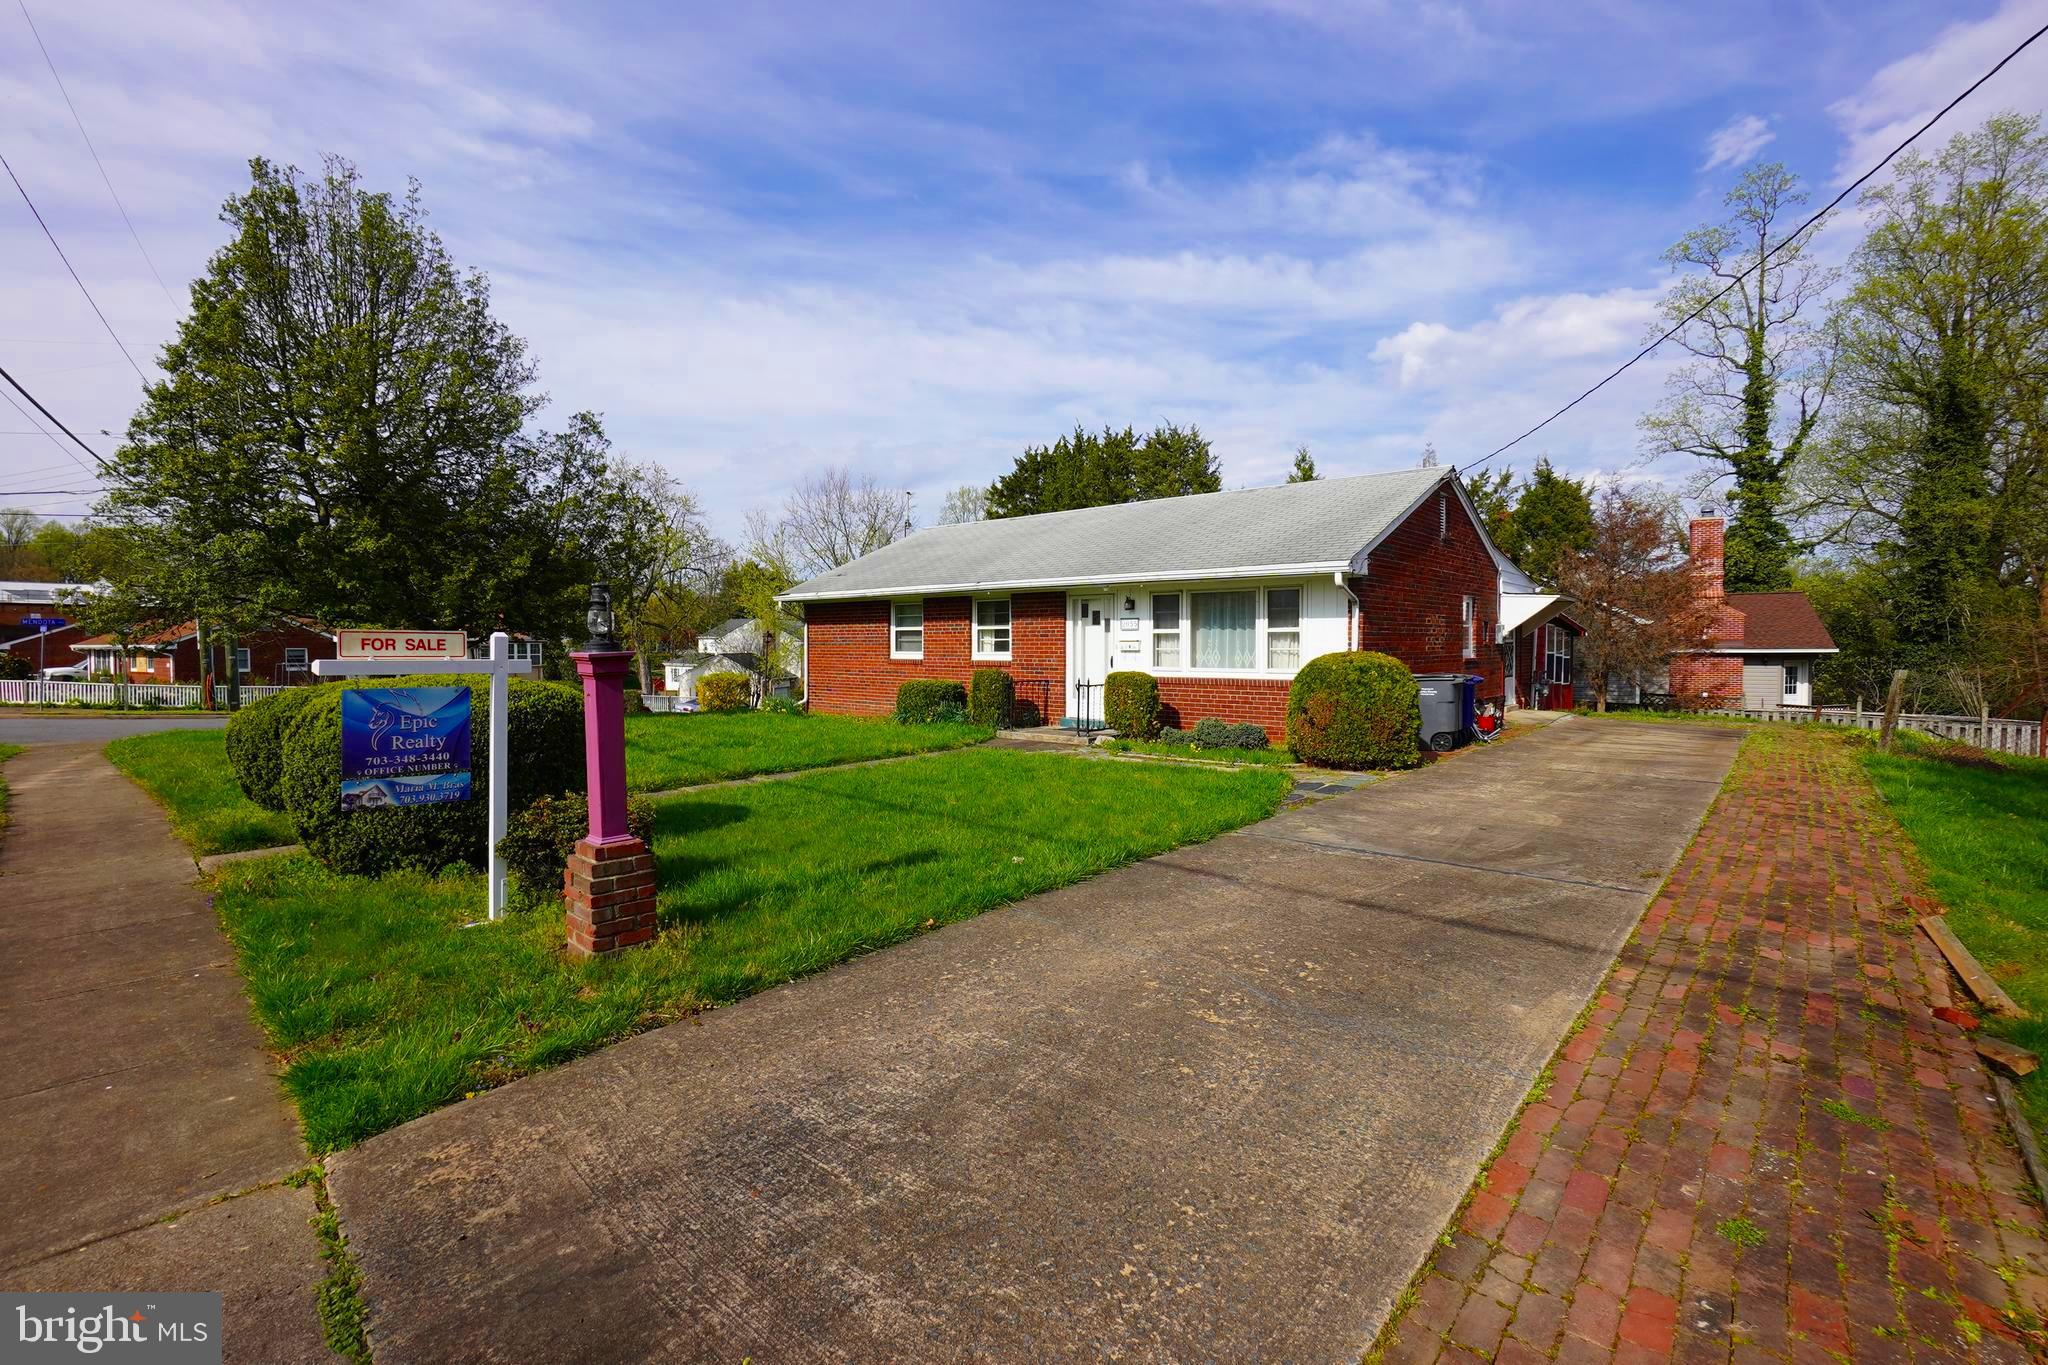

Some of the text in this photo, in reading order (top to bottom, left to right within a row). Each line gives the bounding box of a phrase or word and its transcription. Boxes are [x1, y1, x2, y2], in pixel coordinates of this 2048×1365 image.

[361, 638, 447, 651] FOR SALE
[400, 715, 438, 732] Epic
[391, 735, 447, 750] Realty
[365, 752, 450, 766] 703-348-3440
[364, 763, 451, 776] OFFICE NUMBER
[399, 790, 460, 804] 703.930.3719
